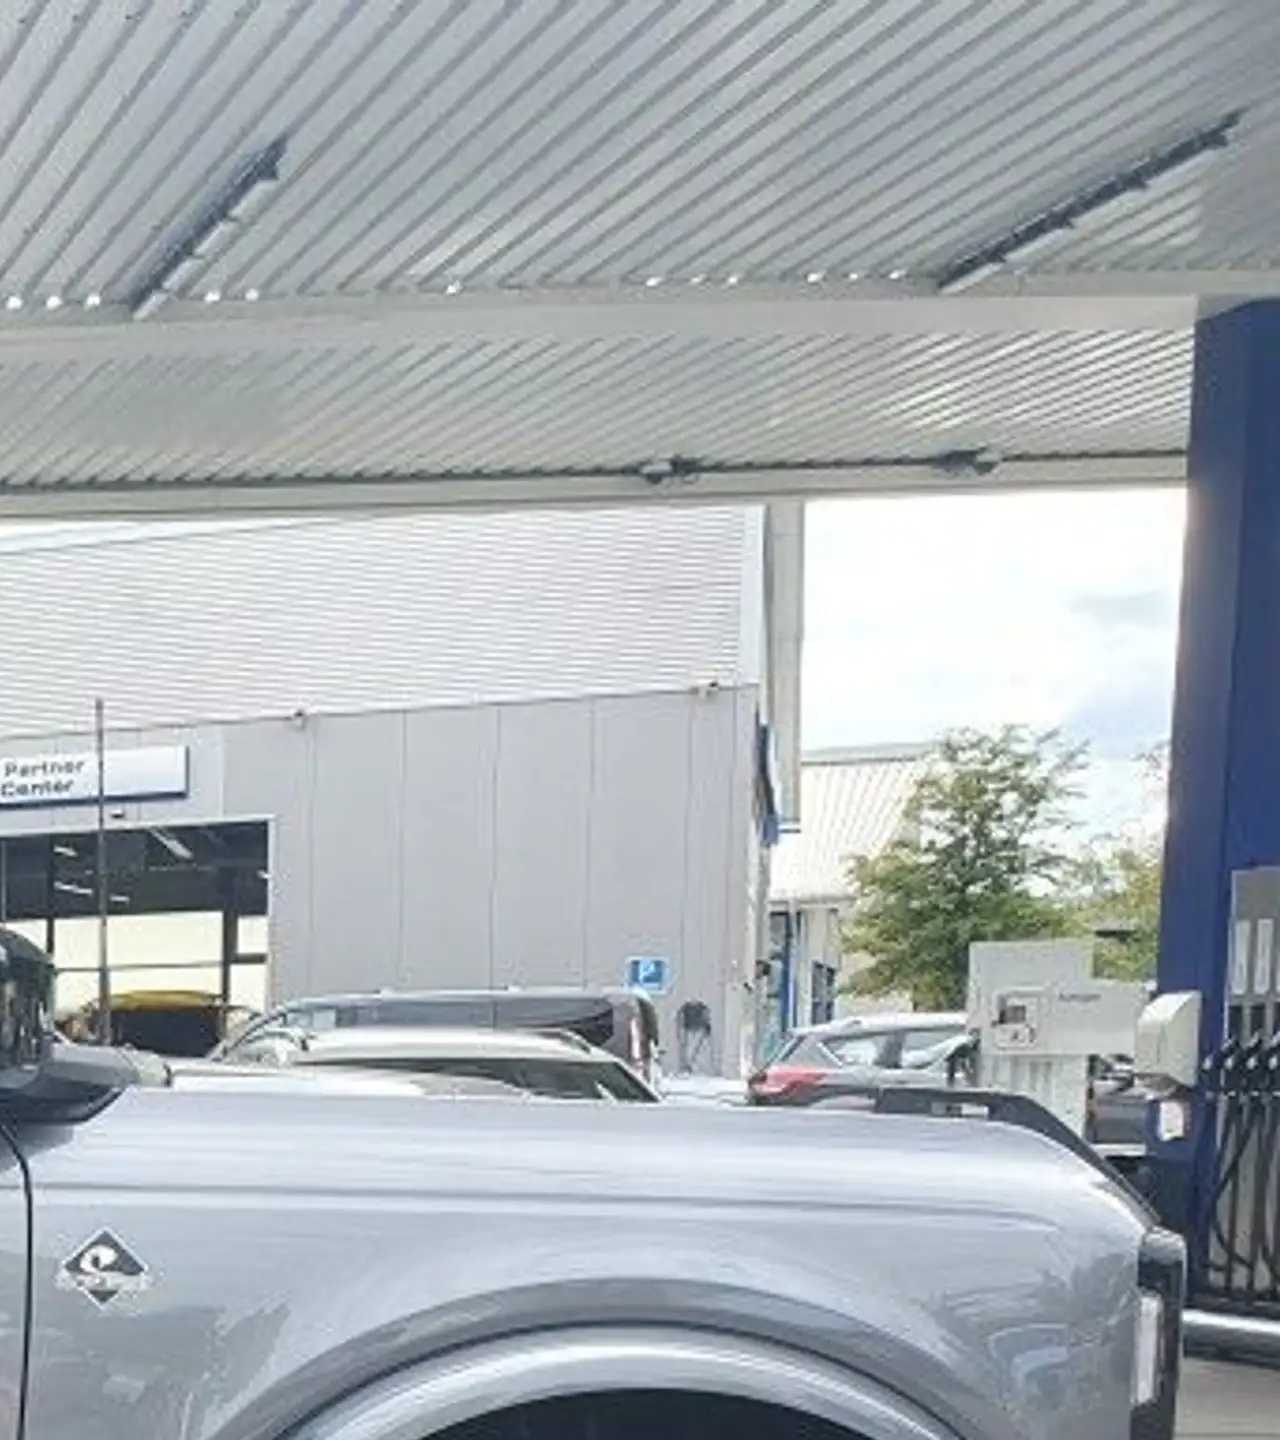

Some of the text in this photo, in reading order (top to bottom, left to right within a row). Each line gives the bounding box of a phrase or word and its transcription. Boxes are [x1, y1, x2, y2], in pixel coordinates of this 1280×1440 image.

[4, 760, 85, 777] Partner
[0, 779, 74, 797] Center
[638, 961, 656, 982] P
